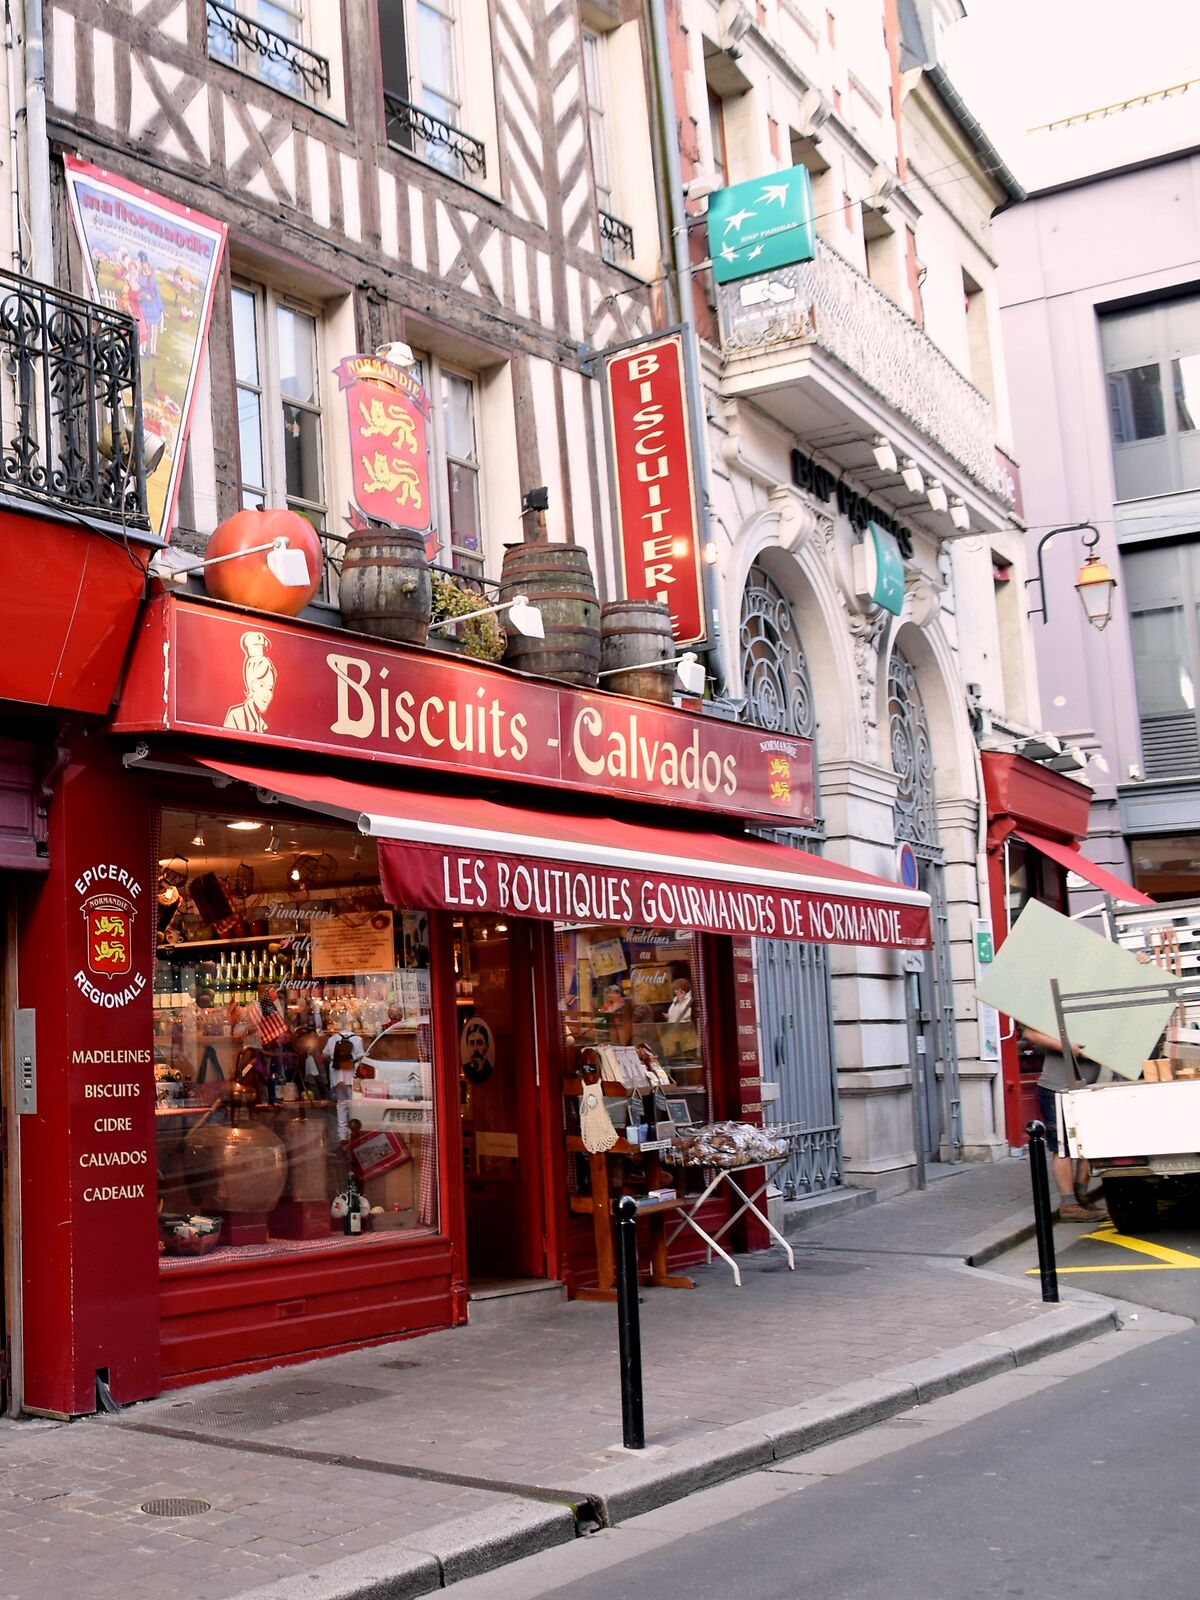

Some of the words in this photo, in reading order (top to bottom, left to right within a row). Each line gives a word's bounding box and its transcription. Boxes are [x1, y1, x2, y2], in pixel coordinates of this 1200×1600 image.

[346, 358, 420, 398] NORMANDIE
[326, 653, 529, 761] Biscuits
[573, 707, 738, 797] Calvados
[759, 739, 797, 759] NORMANDIE
[74, 864, 142, 899] EPICERIE
[89, 896, 129, 911] NORMANDIE
[443, 856, 488, 907] LES
[497, 862, 633, 922] BOUTIQUES
[642, 881, 776, 934] GOURMANDES
[781, 898, 804, 937] DE
[807, 901, 903, 944] NORMANDIE
[622, 927, 670, 945] Madeleines
[639, 951, 652, 960] au
[73, 970, 147, 1009] REGIONALE
[72, 1050, 151, 1064] MADELEINES
[84, 1084, 140, 1098] BISCUITS
[94, 1118, 132, 1132] CIDRE
[79, 1150, 147, 1167] CALVADOS
[83, 1185, 145, 1202] CADEAUX
